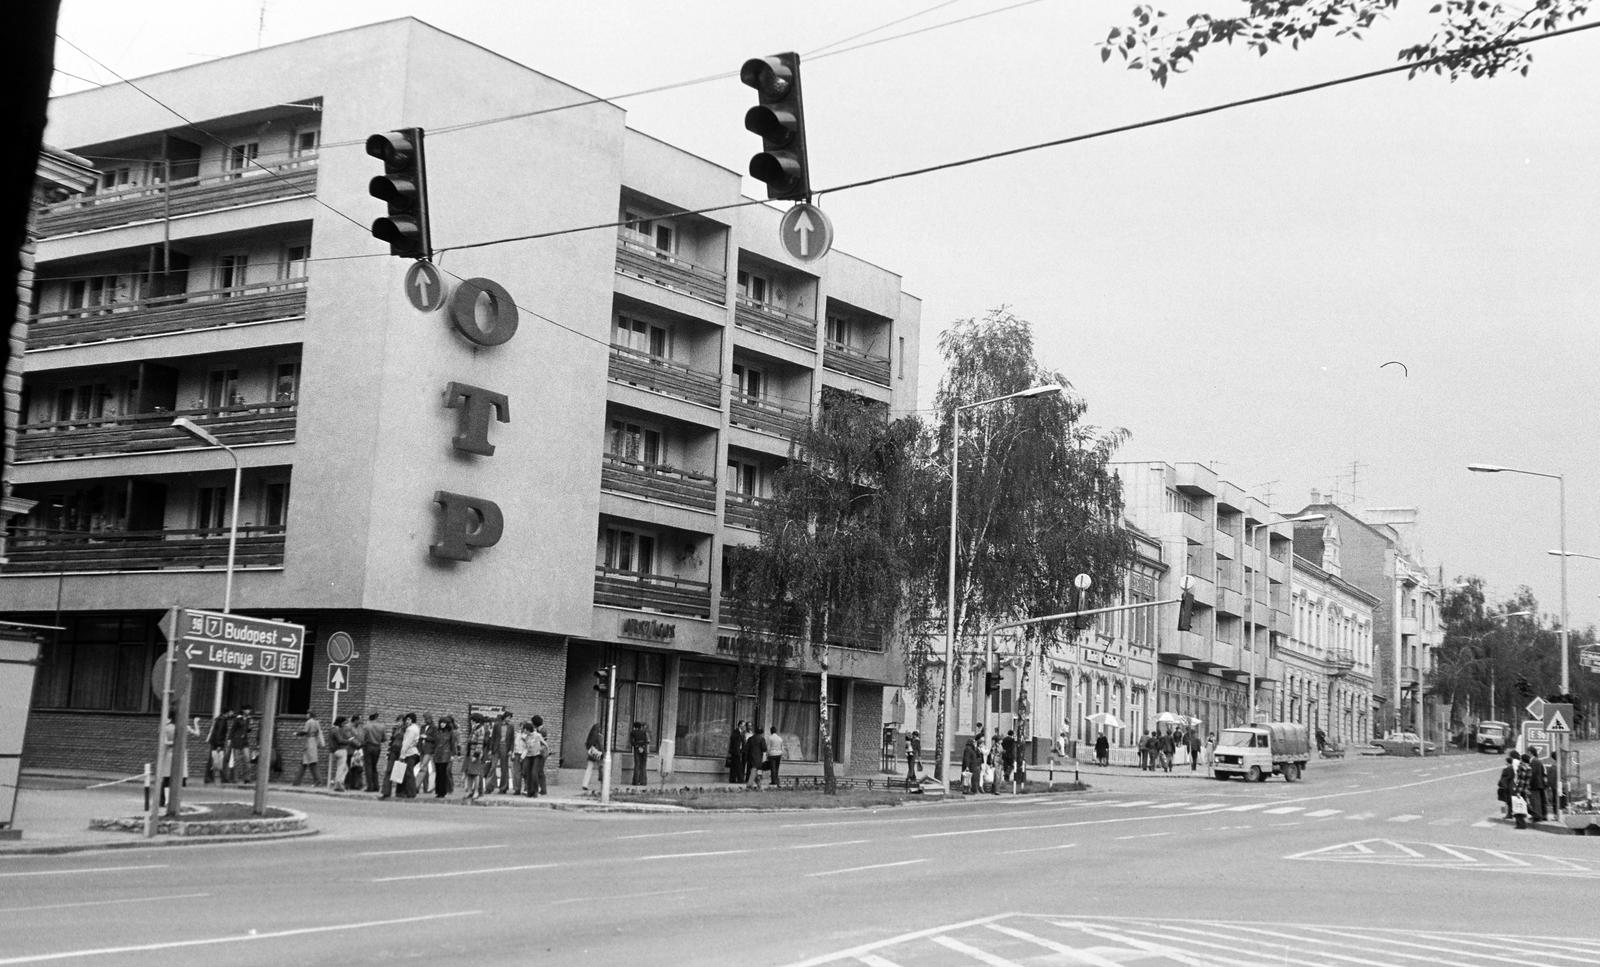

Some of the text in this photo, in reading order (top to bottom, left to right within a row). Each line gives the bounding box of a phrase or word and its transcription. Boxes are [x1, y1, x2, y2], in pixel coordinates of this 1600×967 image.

[430, 277, 518, 561] OTP
[209, 620, 218, 632] 7
[225, 622, 278, 645] Budapest
[209, 643, 253, 669] Letenye
[265, 655, 272, 666] 7
